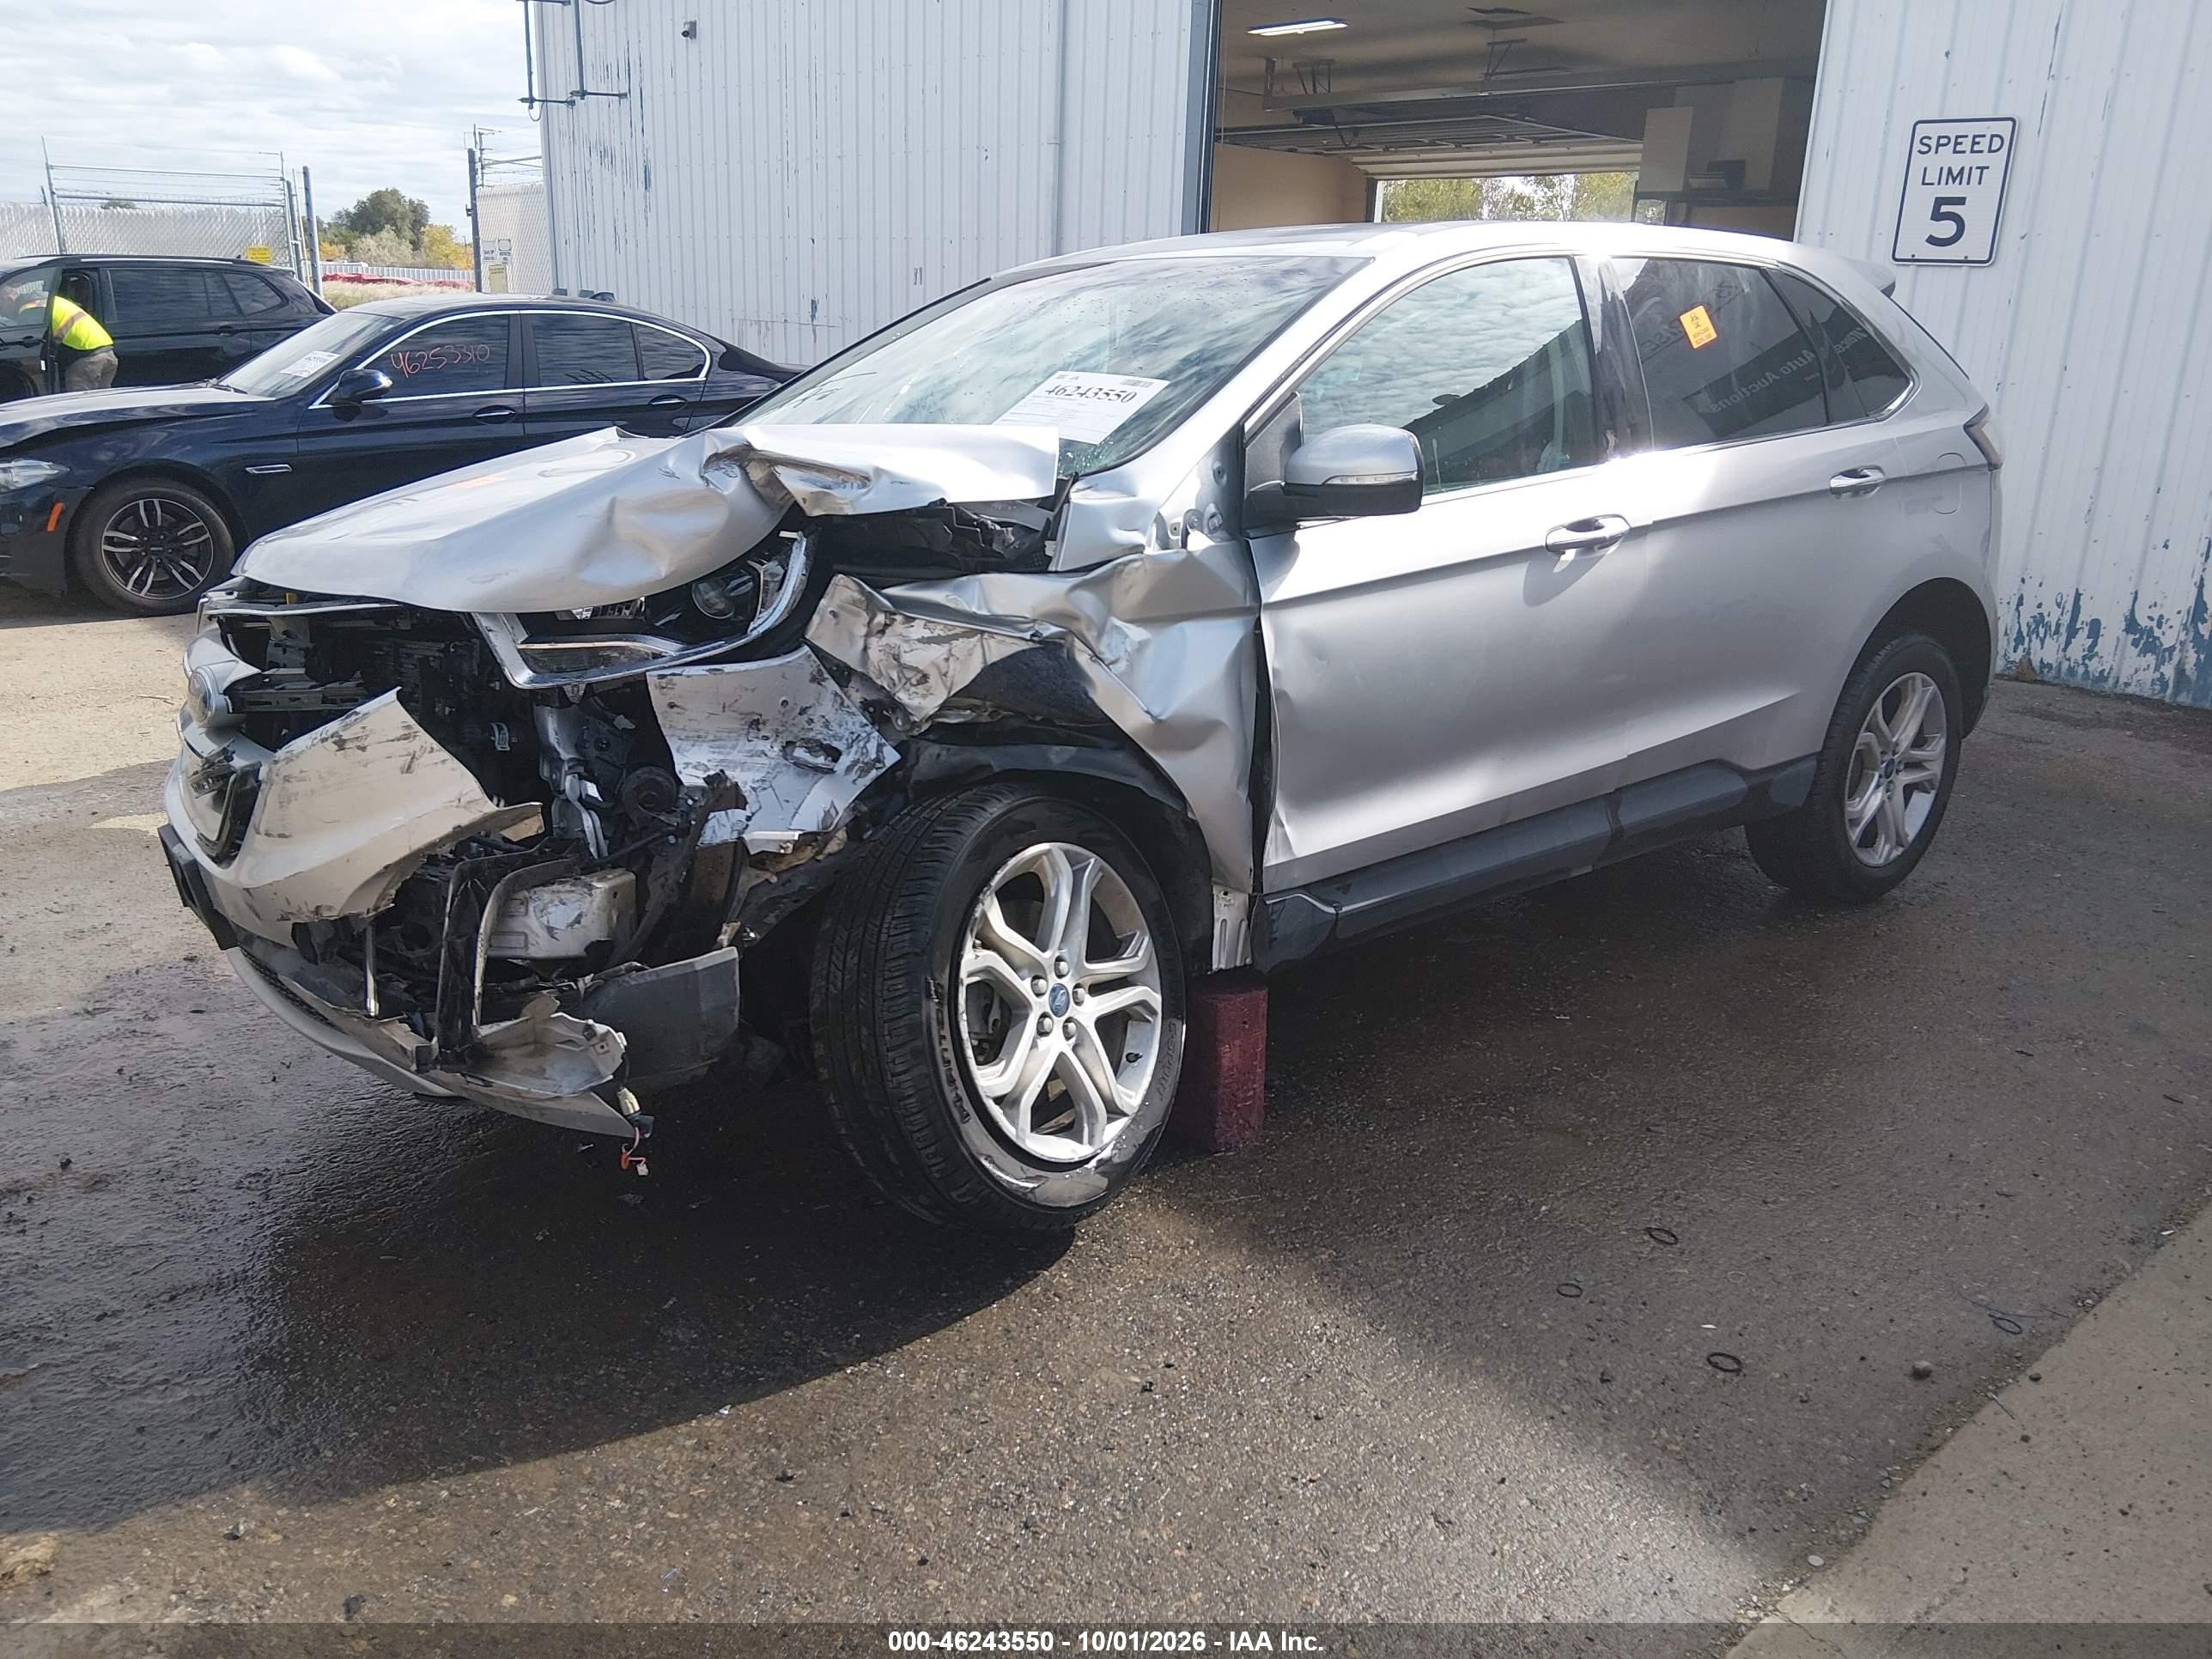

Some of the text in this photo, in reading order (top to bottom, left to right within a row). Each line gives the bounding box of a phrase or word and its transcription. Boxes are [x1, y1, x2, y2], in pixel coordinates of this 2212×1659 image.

[1917, 133, 2005, 155] SPEED
[1920, 166, 1990, 186] LIMIT
[1924, 196, 1967, 247] 5
[1045, 385, 1138, 404] 46243550
